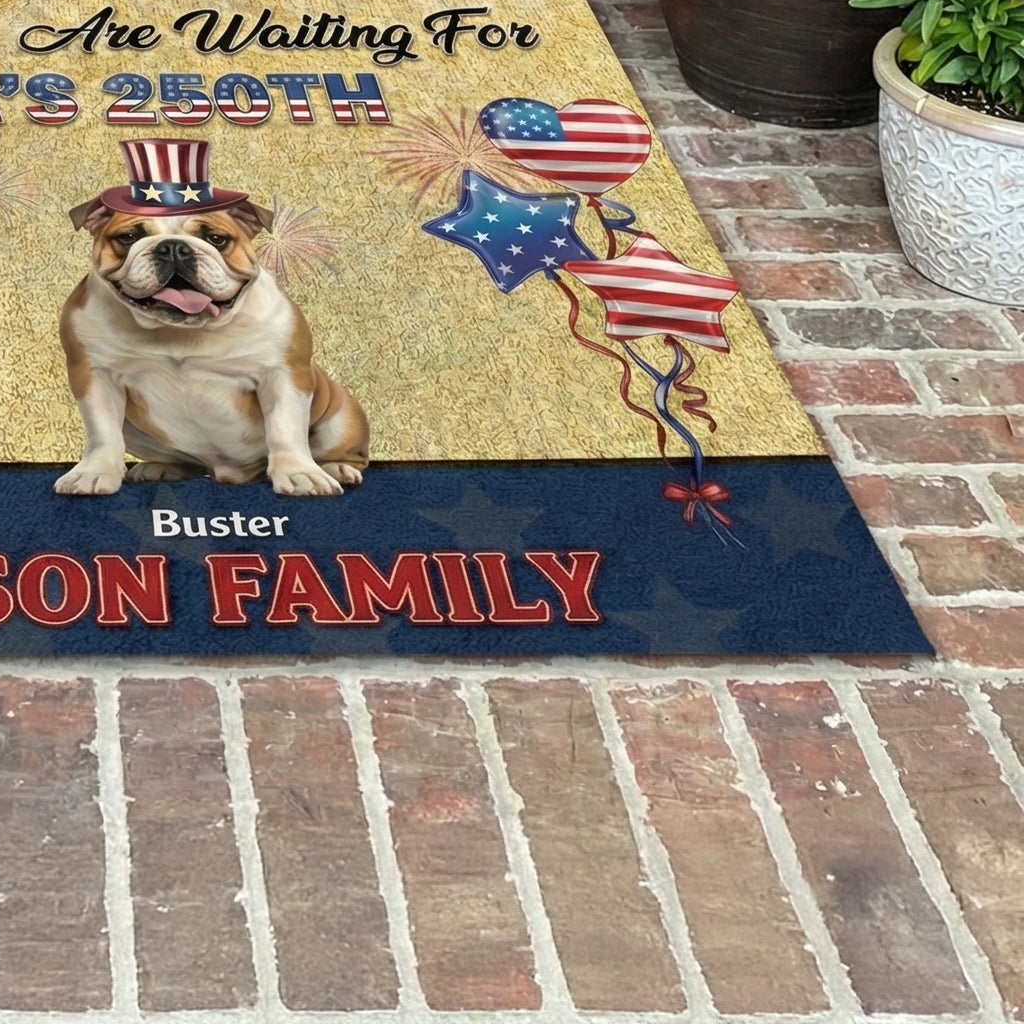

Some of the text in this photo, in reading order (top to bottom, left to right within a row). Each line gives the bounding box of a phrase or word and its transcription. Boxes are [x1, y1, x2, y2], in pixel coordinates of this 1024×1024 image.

[19, 5, 161, 54] Are
[173, 8, 418, 67] Waiting
[424, 6, 540, 55] For
[102, 73, 392, 125] 250TH
[151, 508, 290, 539] Buster
[204, 551, 602, 626] FAMILY
